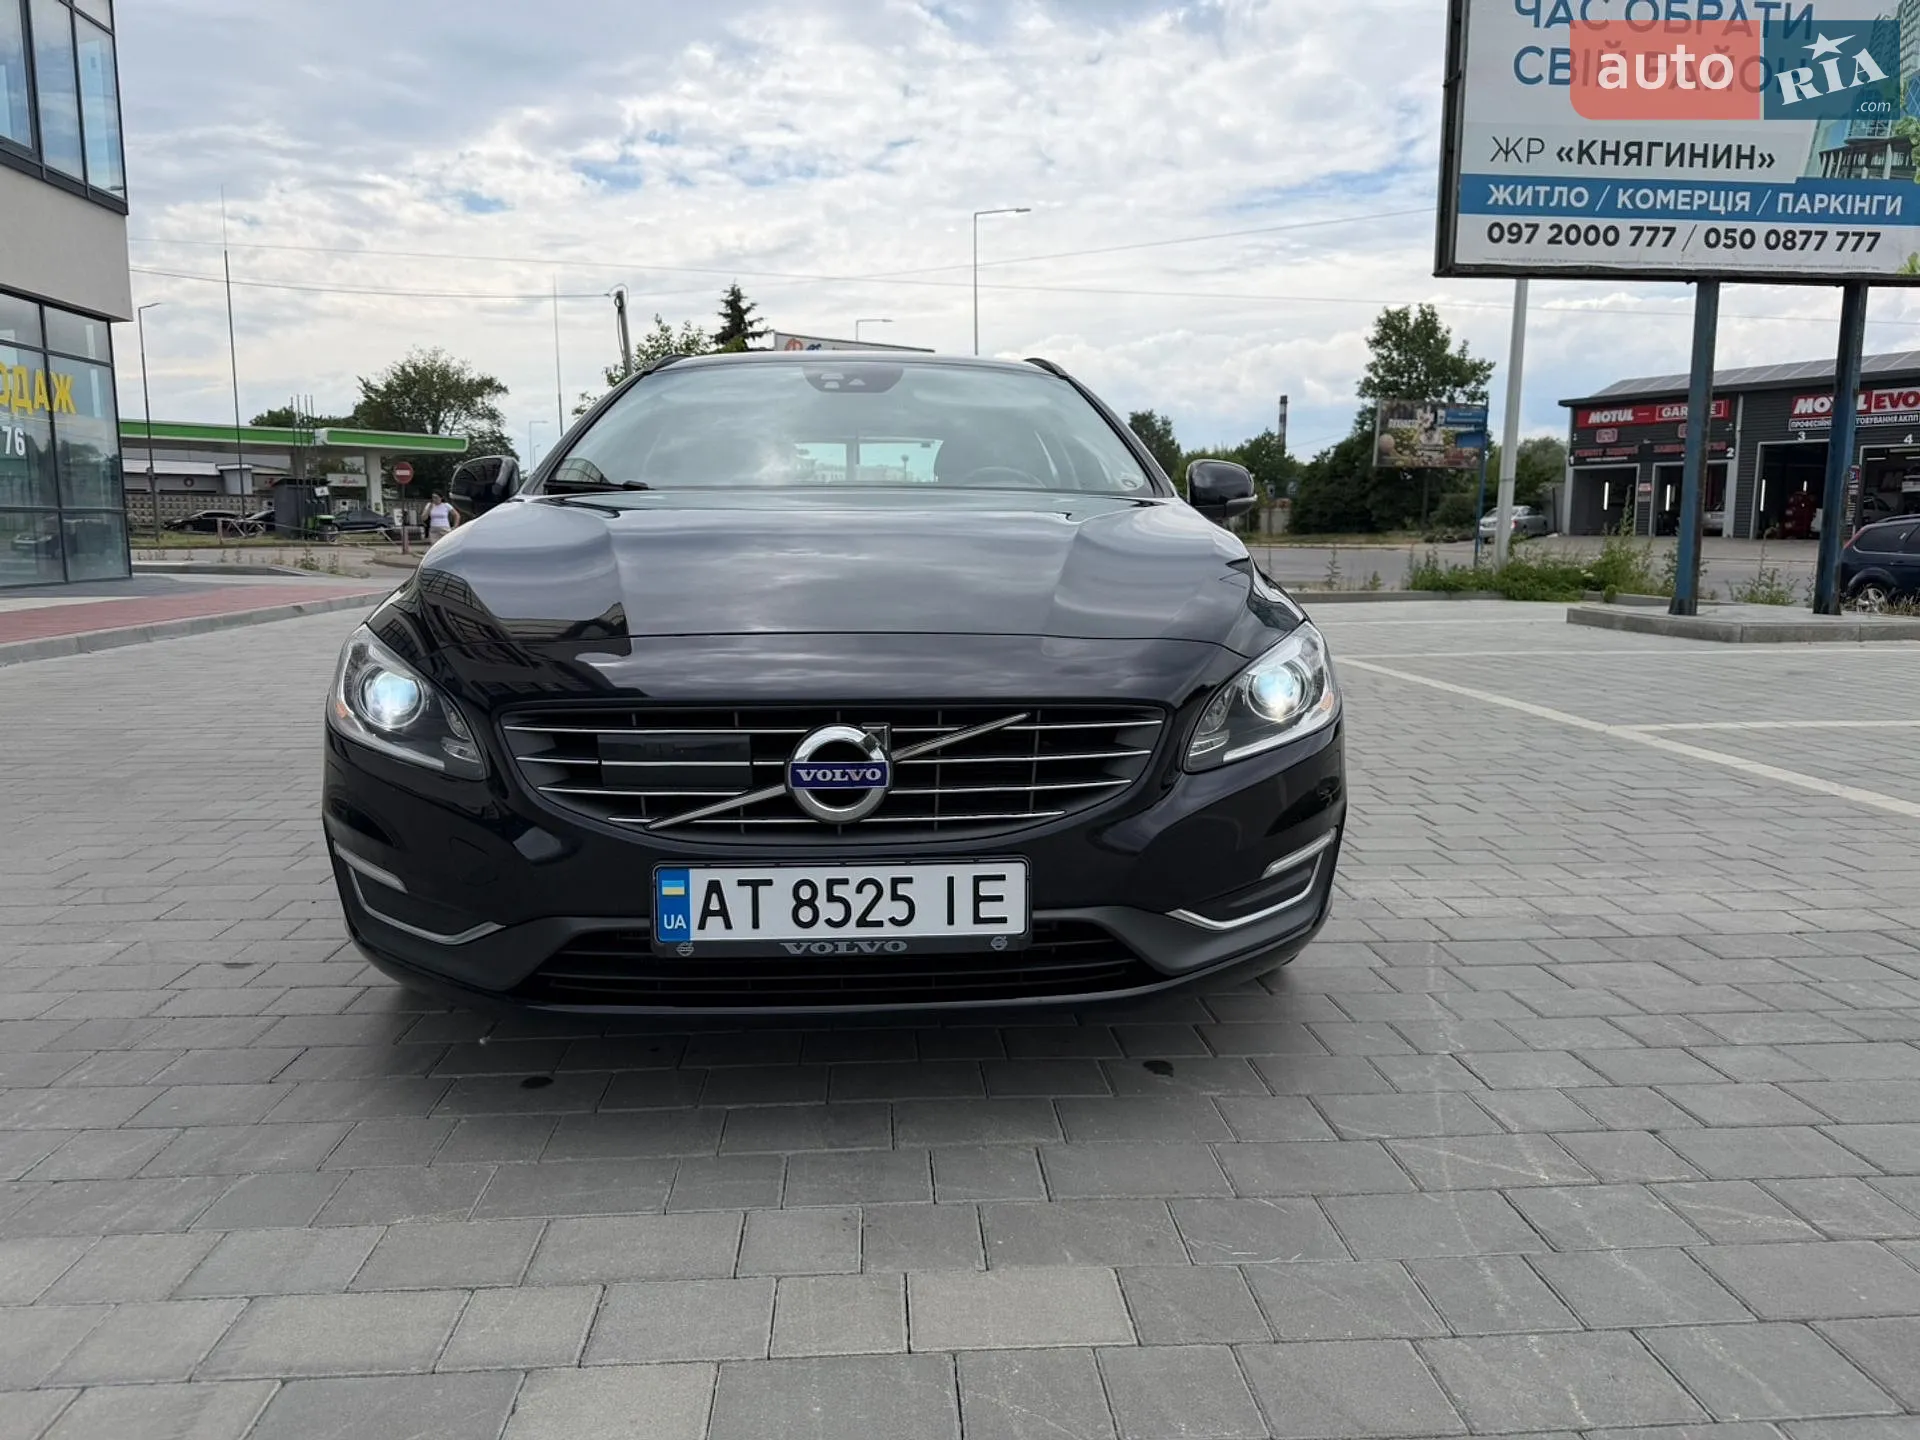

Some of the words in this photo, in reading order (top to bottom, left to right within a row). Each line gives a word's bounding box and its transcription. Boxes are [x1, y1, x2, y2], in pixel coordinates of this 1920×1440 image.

[1515, 0, 1608, 31] ЧАС
[1624, 0, 1813, 40] ОБРАТИ
[1490, 136, 1545, 163] ЖР
[1556, 139, 1775, 168] «КНЯГИНИН»
[1487, 184, 1589, 207] ЖИТЛО
[1617, 188, 1750, 215] КОМЕРЦІЯ
[1777, 193, 1903, 215] ПАРКІНГИ
[1487, 222, 1540, 244] 097
[1547, 223, 1620, 246] 2000
[1629, 226, 1677, 247] 777
[1704, 227, 1756, 249] 050
[1764, 229, 1828, 251] 0877
[1835, 231, 1881, 252] 777
[1588, 409, 1634, 424] MOTUL
[1662, 403, 1717, 417] GARE
[1793, 395, 1868, 414] MOL
[1798, 431, 1806, 440] 3
[1903, 434, 1913, 444] 4
[1726, 447, 1735, 457] 2
[796, 768, 882, 782] VOLVO
[698, 879, 773, 930] AT
[792, 876, 916, 929] 8525
[946, 874, 1008, 926] IE
[664, 914, 687, 930] UA
[780, 939, 907, 955] VOLVO
